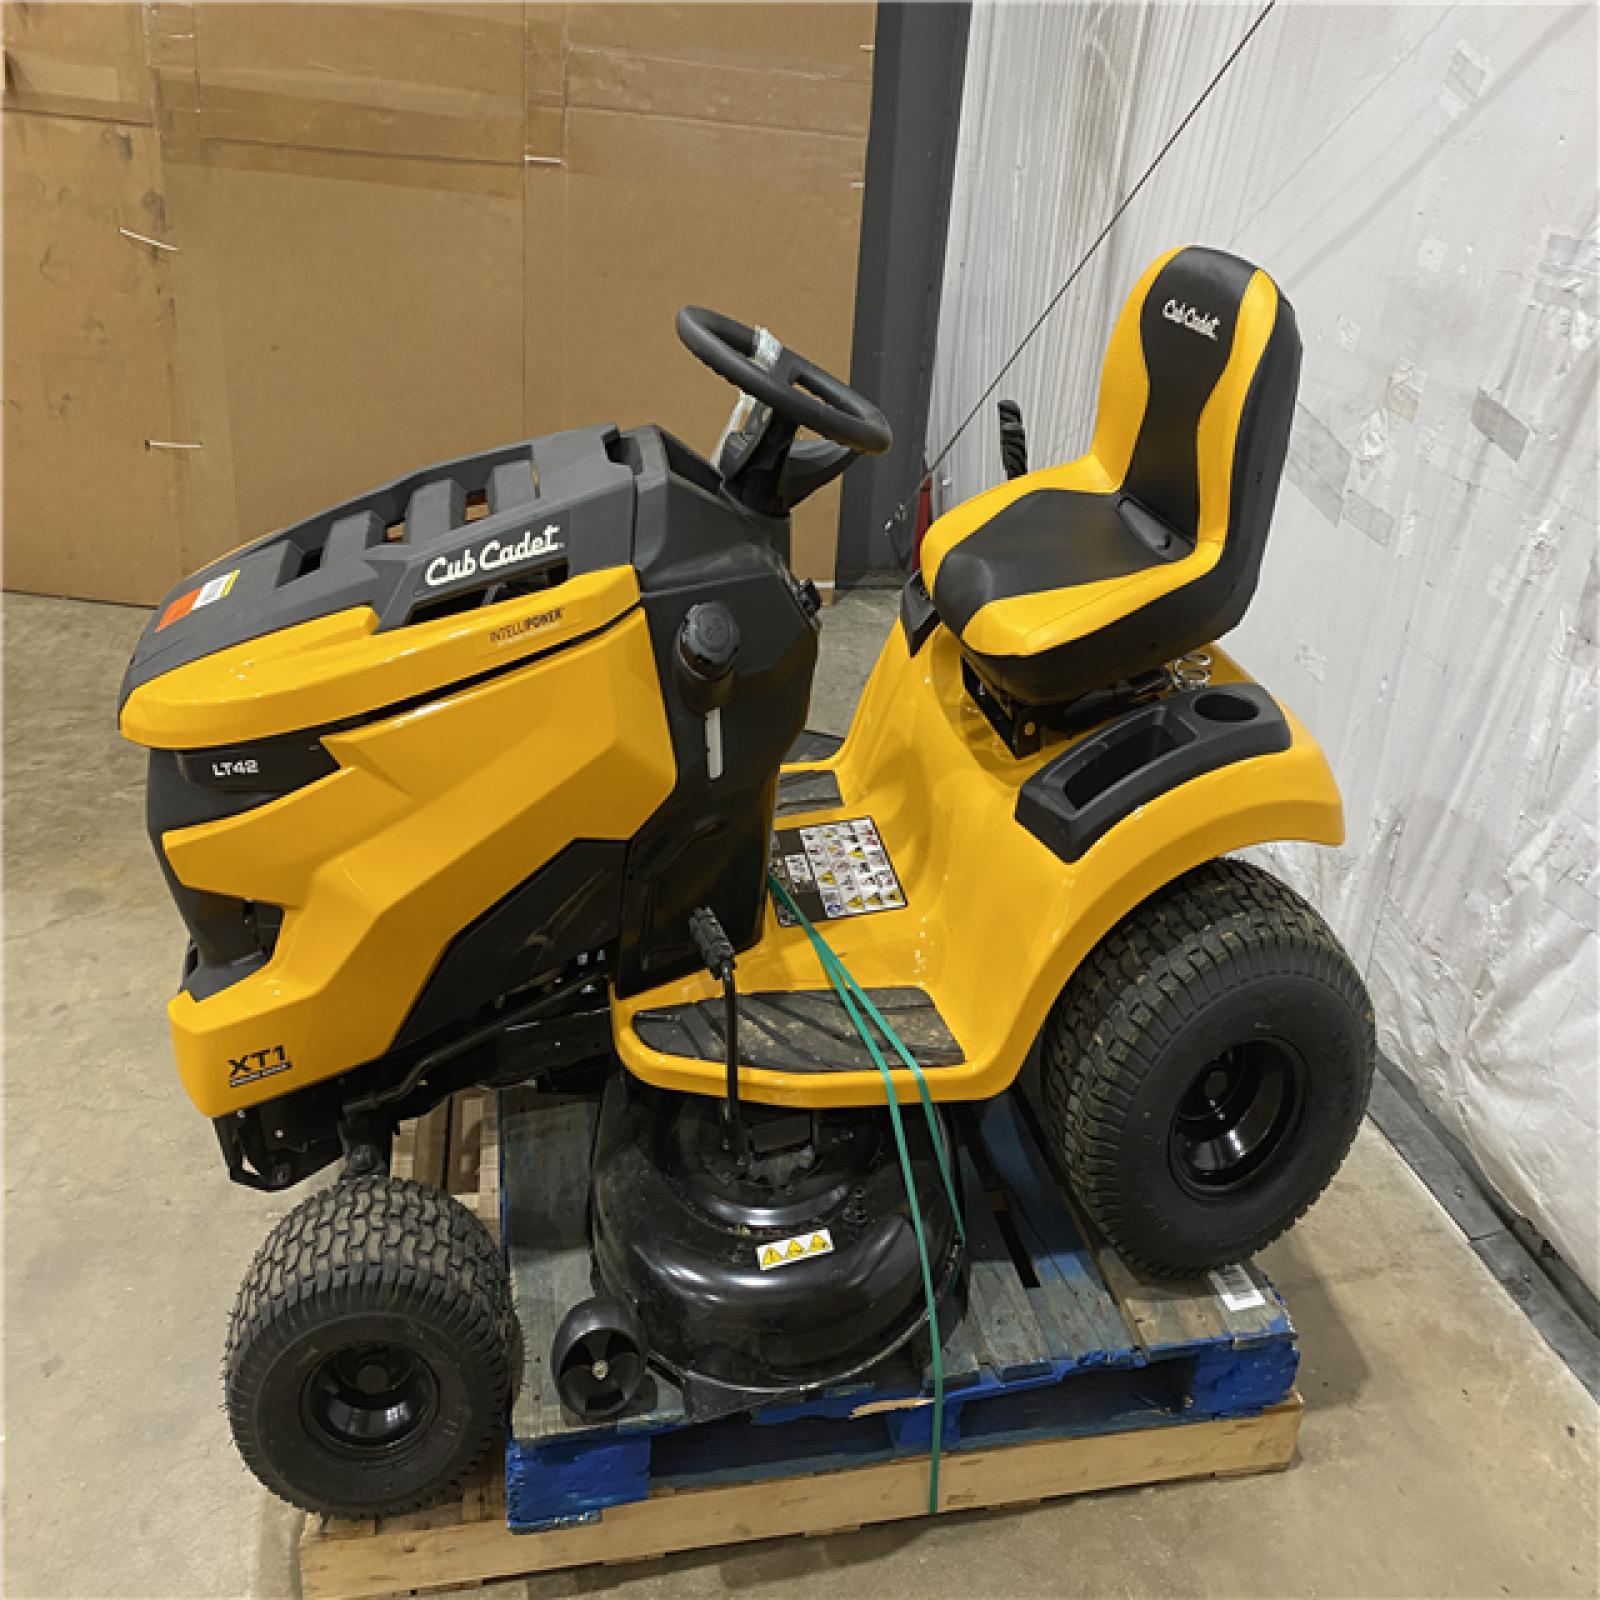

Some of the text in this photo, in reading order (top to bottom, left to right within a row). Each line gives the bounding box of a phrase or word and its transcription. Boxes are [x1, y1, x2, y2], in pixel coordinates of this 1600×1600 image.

[1163, 299, 1221, 339] Cub Cadet
[425, 525, 561, 586] Cub Cadet
[490, 607, 563, 642] INTELLIPOWER
[212, 759, 259, 776] LT42
[228, 1044, 286, 1076] XT1
